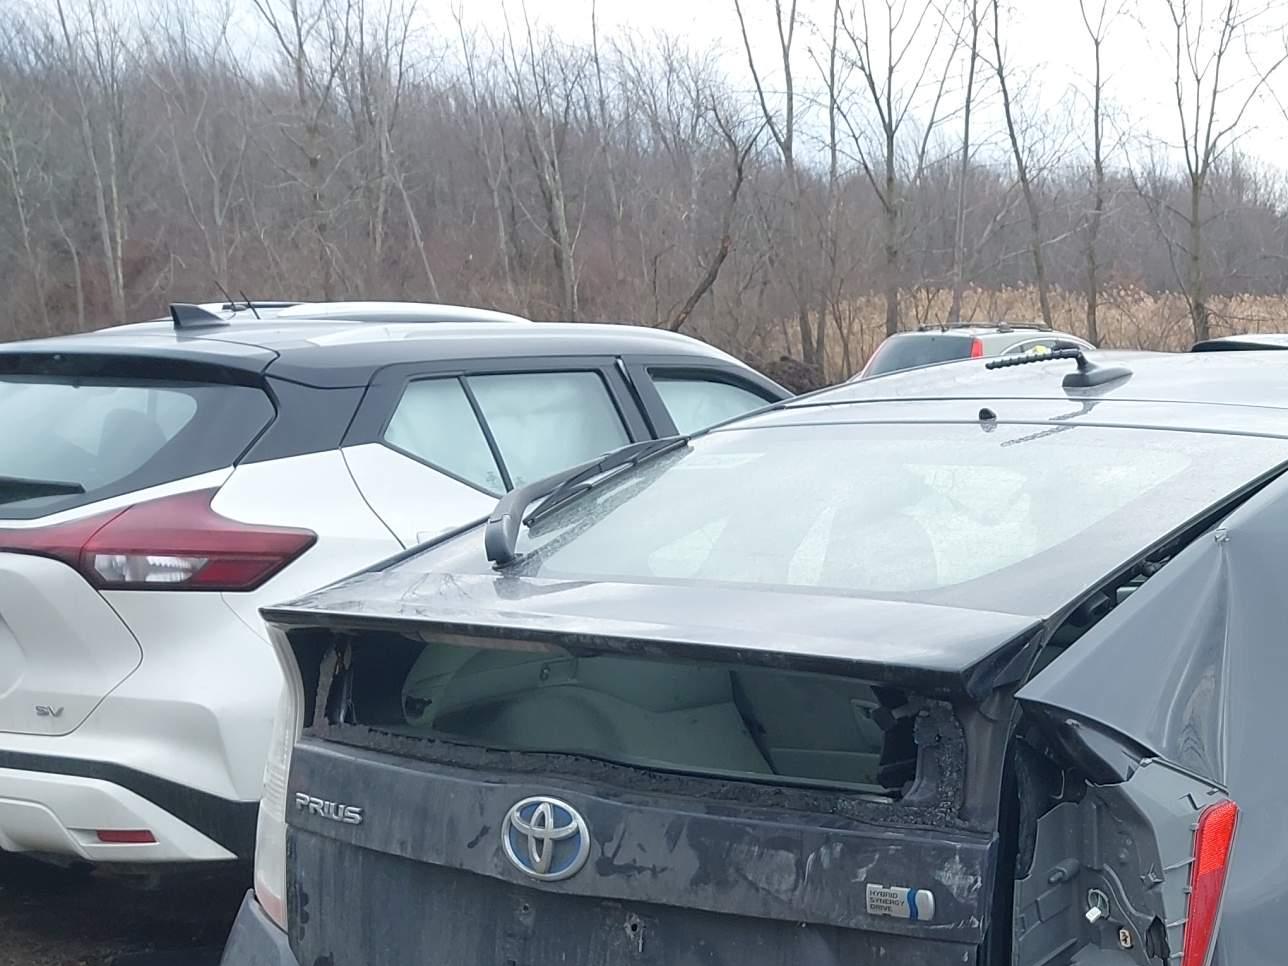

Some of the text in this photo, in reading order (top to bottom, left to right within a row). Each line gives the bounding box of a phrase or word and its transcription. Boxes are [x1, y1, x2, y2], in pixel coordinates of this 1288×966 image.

[35, 705, 64, 717] SV
[295, 792, 363, 825] PRIUS
[870, 890, 898, 899] HYBRID
[870, 897, 905, 906] SYNERGY
[870, 904, 893, 912] DRIVE
